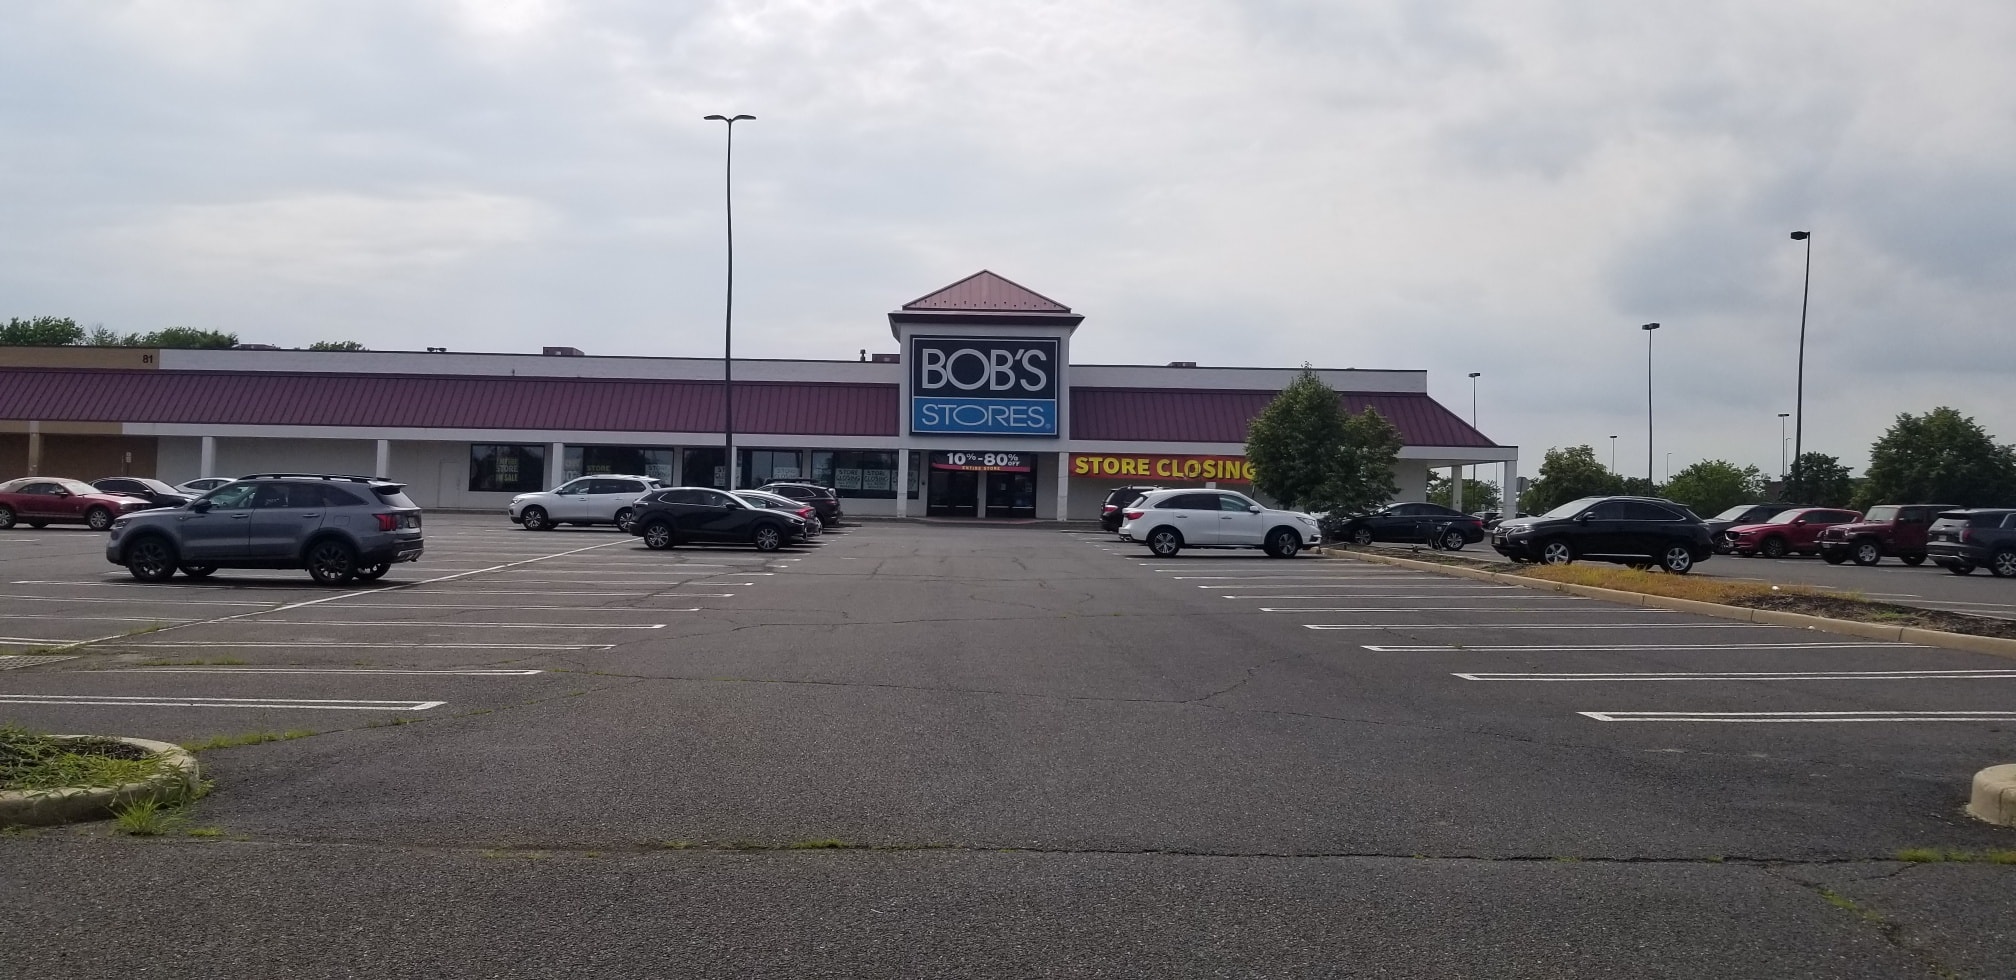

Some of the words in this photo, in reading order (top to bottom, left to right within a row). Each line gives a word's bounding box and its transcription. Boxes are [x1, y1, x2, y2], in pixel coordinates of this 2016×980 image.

[142, 354, 153, 364] 81
[921, 348, 1047, 392] BOB'S
[921, 403, 1045, 429] STORES
[495, 465, 518, 473] STORE
[587, 464, 611, 472] STORE
[1075, 456, 1150, 476] STORE
[1156, 458, 1256, 480] CLOSING
